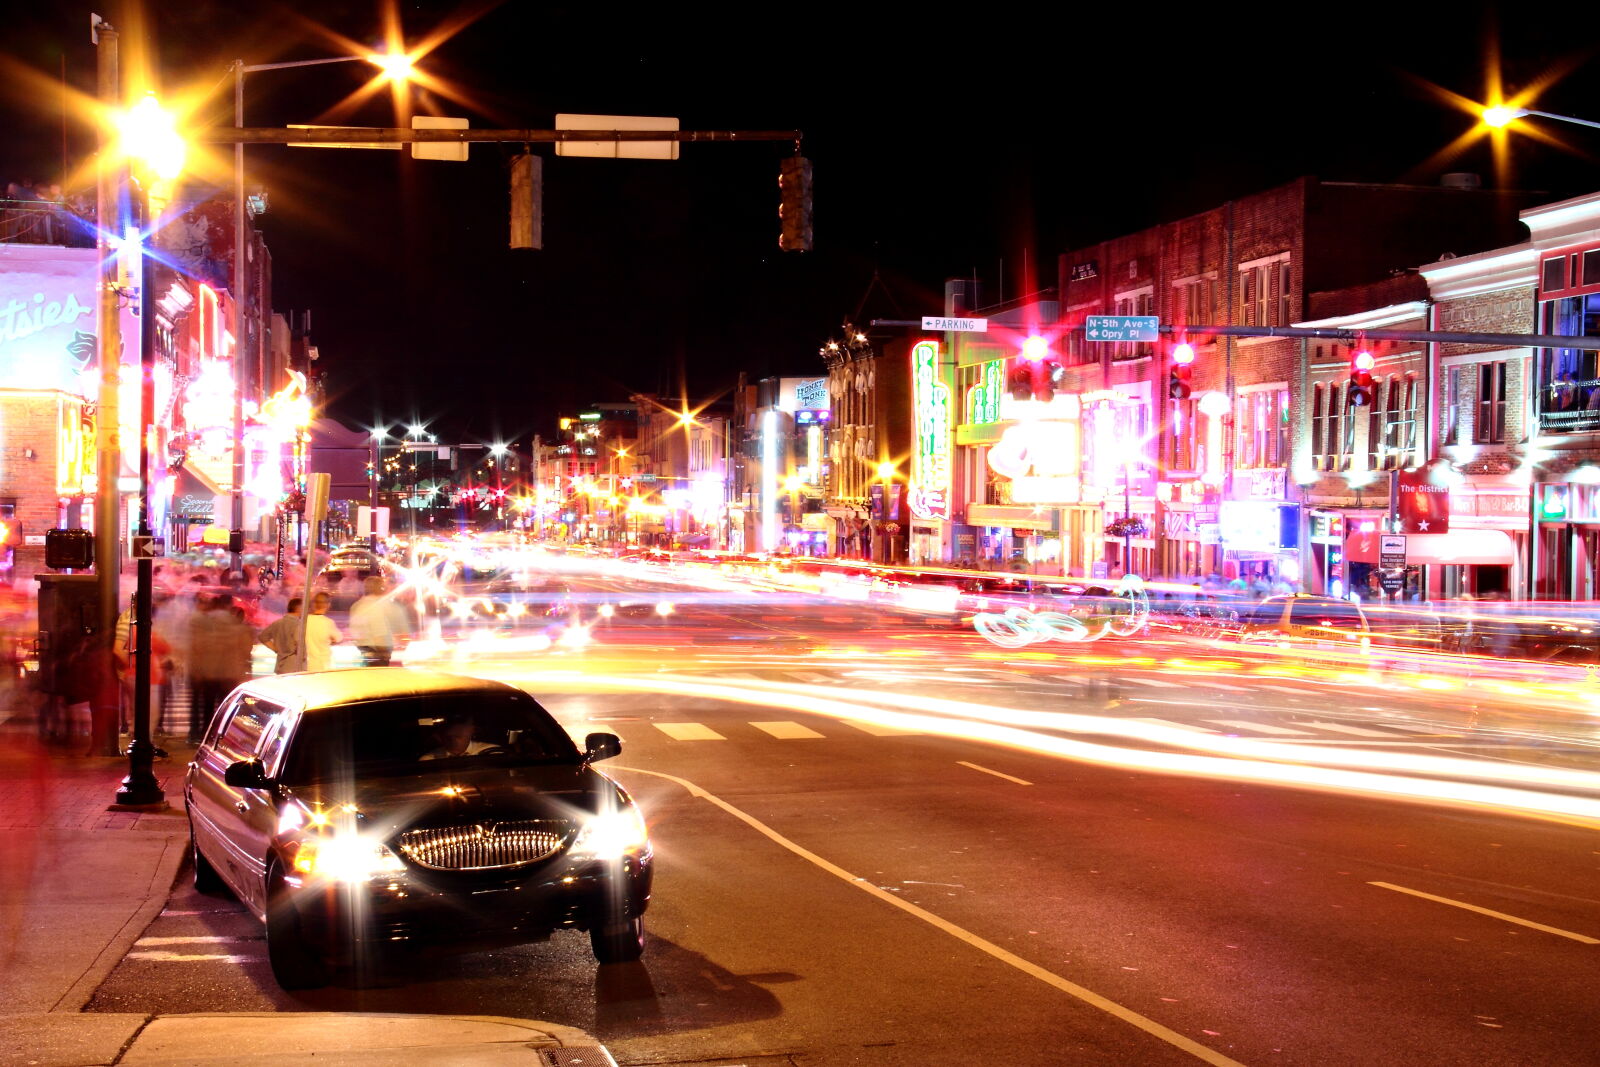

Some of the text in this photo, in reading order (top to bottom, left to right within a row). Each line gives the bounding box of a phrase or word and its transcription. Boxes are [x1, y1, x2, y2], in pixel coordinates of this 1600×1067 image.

[0, 292, 93, 342] tsies
[935, 319, 975, 330] PARKING
[1089, 319, 1156, 328] N-5th Ave-S
[1101, 329, 1140, 340] Opry Pl
[1401, 484, 1416, 493] The
[180, 494, 214, 506] Secon
[181, 502, 214, 514] Fiddl
